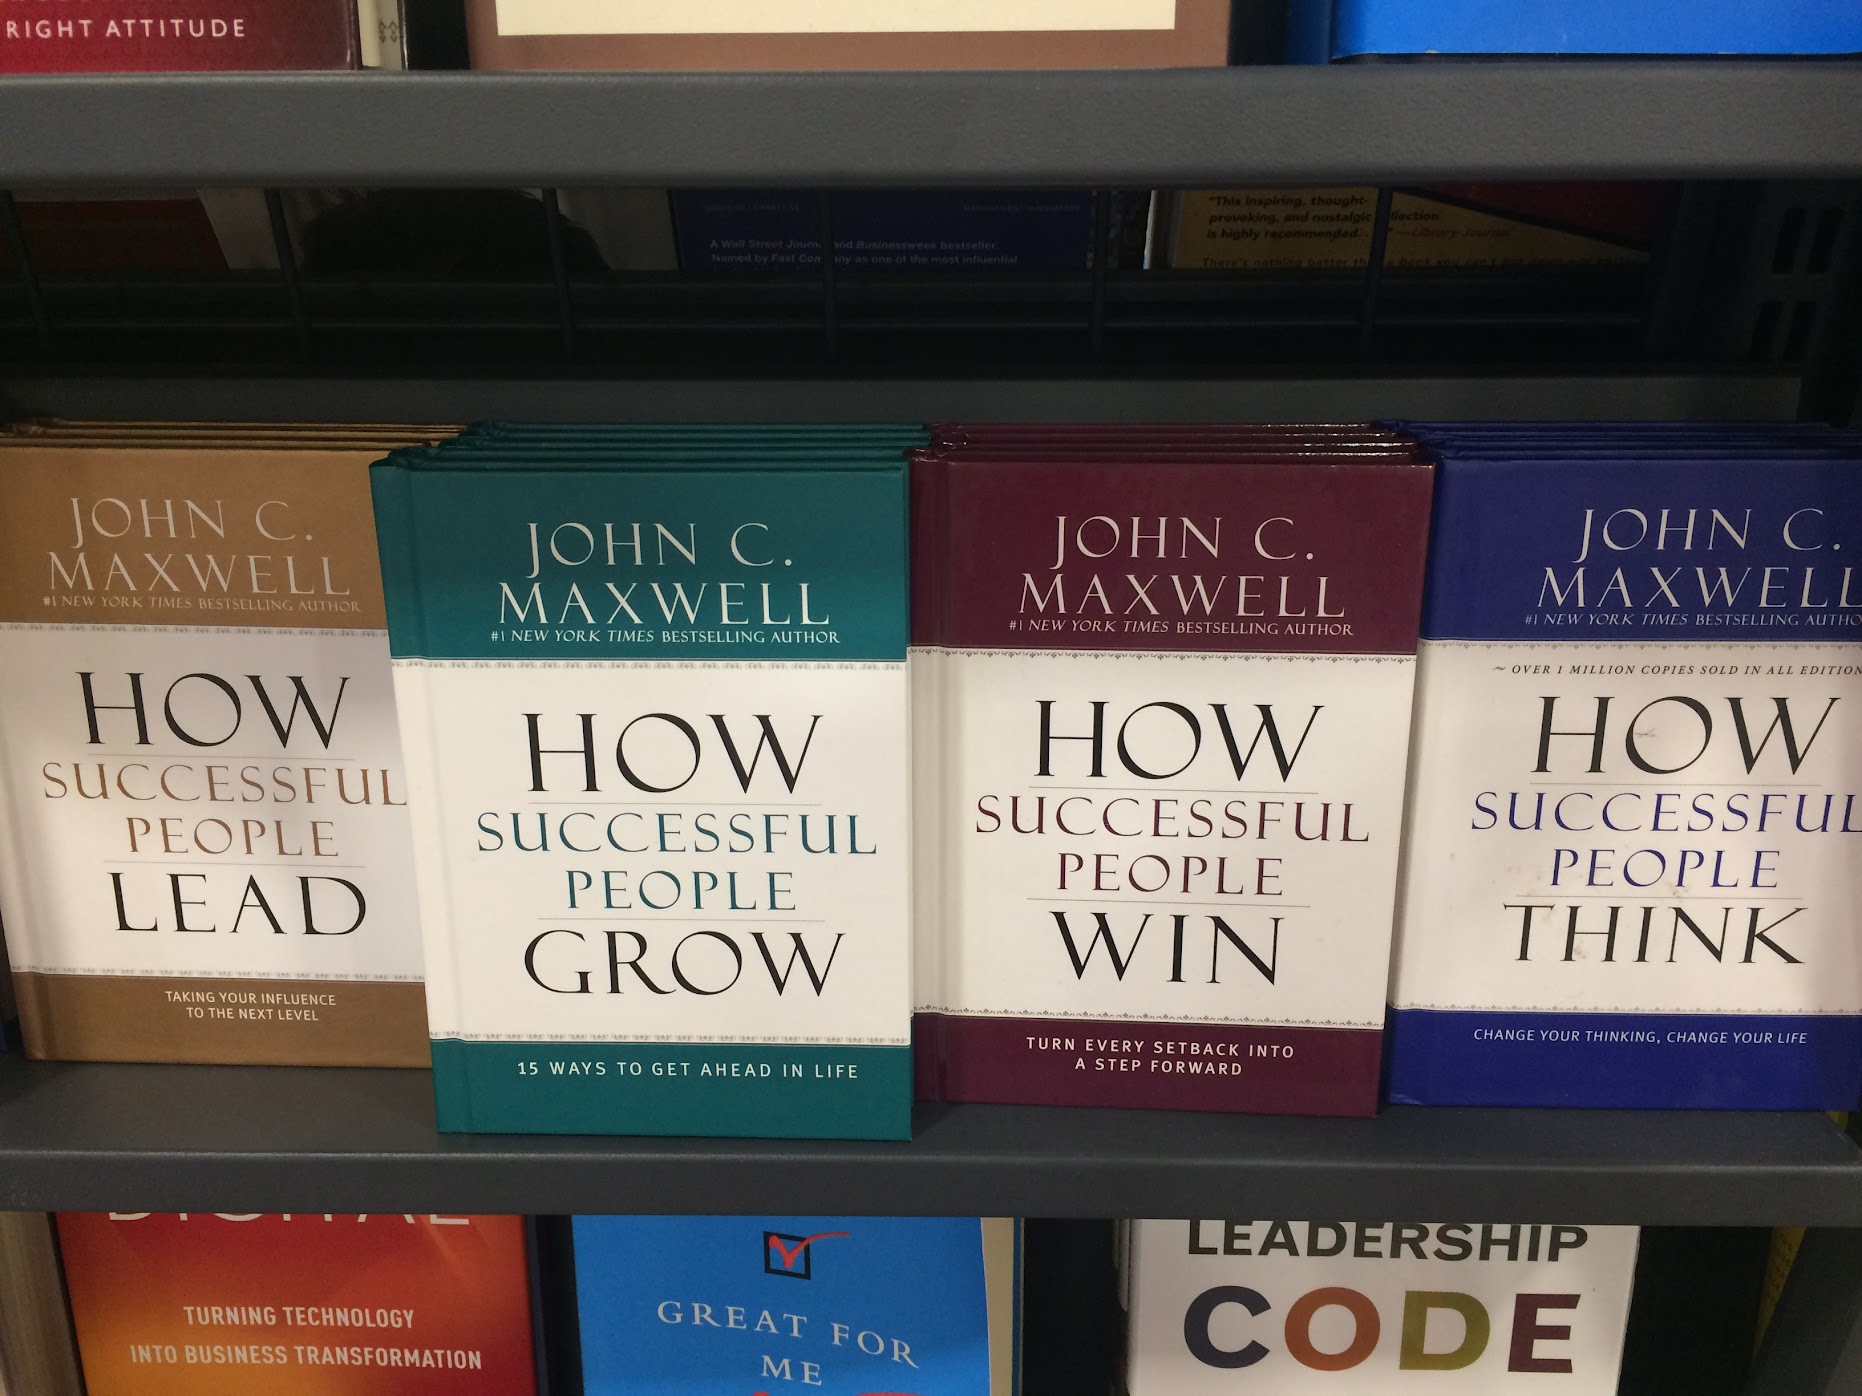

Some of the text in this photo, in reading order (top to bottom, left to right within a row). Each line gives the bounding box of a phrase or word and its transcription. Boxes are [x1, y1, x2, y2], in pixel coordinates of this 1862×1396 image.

[7, 19, 246, 38] RIGHT ATTITUDE
[1207, 229, 1217, 239] is
[1221, 228, 1260, 241] highly
[1284, 212, 1309, 223] and
[1312, 213, 1372, 225] nostalgic
[711, 253, 752, 263] Named
[754, 253, 768, 266] by
[771, 253, 796, 263] Fast
[871, 255, 893, 264] one
[895, 254, 907, 264] of
[910, 254, 928, 264] the
[931, 254, 960, 264] most
[963, 254, 1018, 265] influential
[721, 240, 745, 249] Wall
[749, 240, 783, 249] Street
[786, 240, 822, 249] Journ
[856, 240, 937, 249] Businessweek
[70, 497, 314, 549] JOHN C.
[1048, 515, 1315, 570] JOHN C.
[1572, 508, 1842, 563] JOHN C.
[525, 522, 793, 579] JOHN C.
[48, 551, 351, 596] MAXWELL
[1536, 566, 1862, 608] MAXWELL
[43, 596, 361, 613] #1 NEW YORK TIMES BESTSELLING AUTHOR
[499, 582, 830, 625] MAXWELL
[1018, 572, 1346, 618] MAXWELL
[490, 630, 842, 644] #1 NEW YORK TIMES BESTSELLING AUTHOR
[1008, 620, 1354, 636] #1 NEW YORK TIMES BESTSELLING AUTHOR
[1524, 613, 1862, 627] #1 NEW YORK TIMES BESTSELLING AUTHO
[1512, 664, 1551, 675] OVER
[1568, 664, 1636, 675] MILLION
[1641, 664, 1695, 676] COPIES
[1699, 665, 1739, 675] SOLD
[1744, 665, 1762, 675] IN
[1766, 665, 1794, 675] ALL
[1800, 665, 1862, 676] EDITION
[76, 671, 352, 750] HOW
[521, 712, 824, 795] HOW
[1034, 699, 1326, 783] HOW
[1530, 695, 1842, 776] HOW
[42, 761, 408, 806] SUCCESSFUL
[477, 811, 878, 855] SUCCESSFUL
[975, 794, 1370, 843] SUCCESSFUL
[1471, 791, 1862, 833] SUCCESSFUL
[126, 816, 340, 857] PEOPLE
[1056, 852, 1284, 896] PEOPLE
[1550, 848, 1781, 888] PEOPLE
[107, 871, 368, 936] LEAD
[565, 870, 797, 911] PEOPLE
[1048, 910, 1286, 986] WIN
[1503, 903, 1809, 964] THINK
[523, 929, 847, 998] GROW
[165, 990, 337, 1006] TAKING YOUR INFLUENCE
[186, 1007, 319, 1021] TO THE NEXT LEVEL
[1026, 1036, 1295, 1059] TURN EVERY SETBACK INTO
[1473, 1028, 1808, 1045] CHANGE YOUR THINKING, CHANGE YOUR LIFE
[518, 1061, 859, 1079] 15 WAYS TO GET AHEAD IN LIFE
[1074, 1057, 1243, 1076] A STEP FORWARD
[1188, 1219, 1589, 1262] LEADERSHIP
[183, 1306, 415, 1329] TURNING TECHNOLOGY
[657, 1300, 920, 1369] GREAT FOR
[1183, 1285, 1582, 1374] CODE
[130, 1344, 482, 1370] INTO BUSINESS TRANSFORMATION
[760, 1354, 823, 1387] ME
